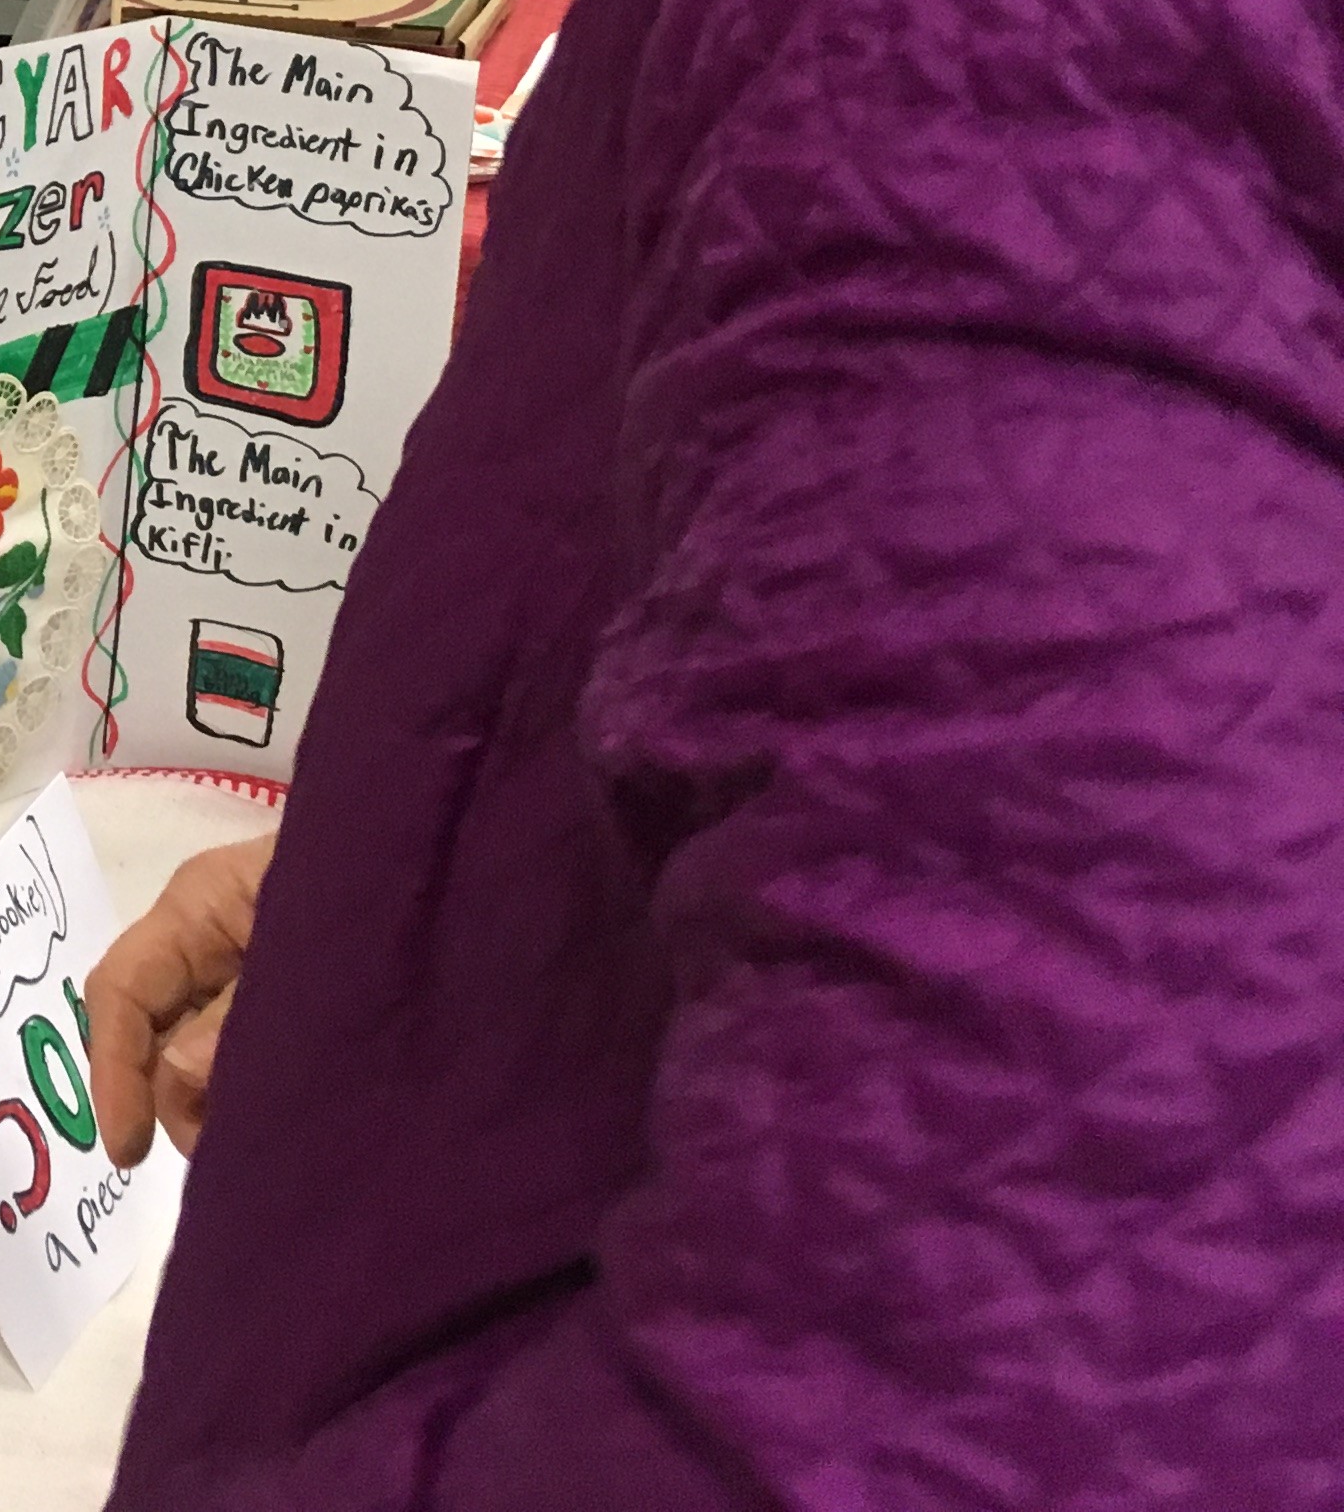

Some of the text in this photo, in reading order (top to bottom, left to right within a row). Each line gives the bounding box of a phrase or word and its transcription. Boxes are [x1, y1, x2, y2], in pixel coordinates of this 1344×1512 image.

[199, 39, 374, 105] The Main
[173, 100, 419, 177] Ingredient in
[158, 420, 323, 498] The Main
[148, 478, 359, 552] Ingredient in
